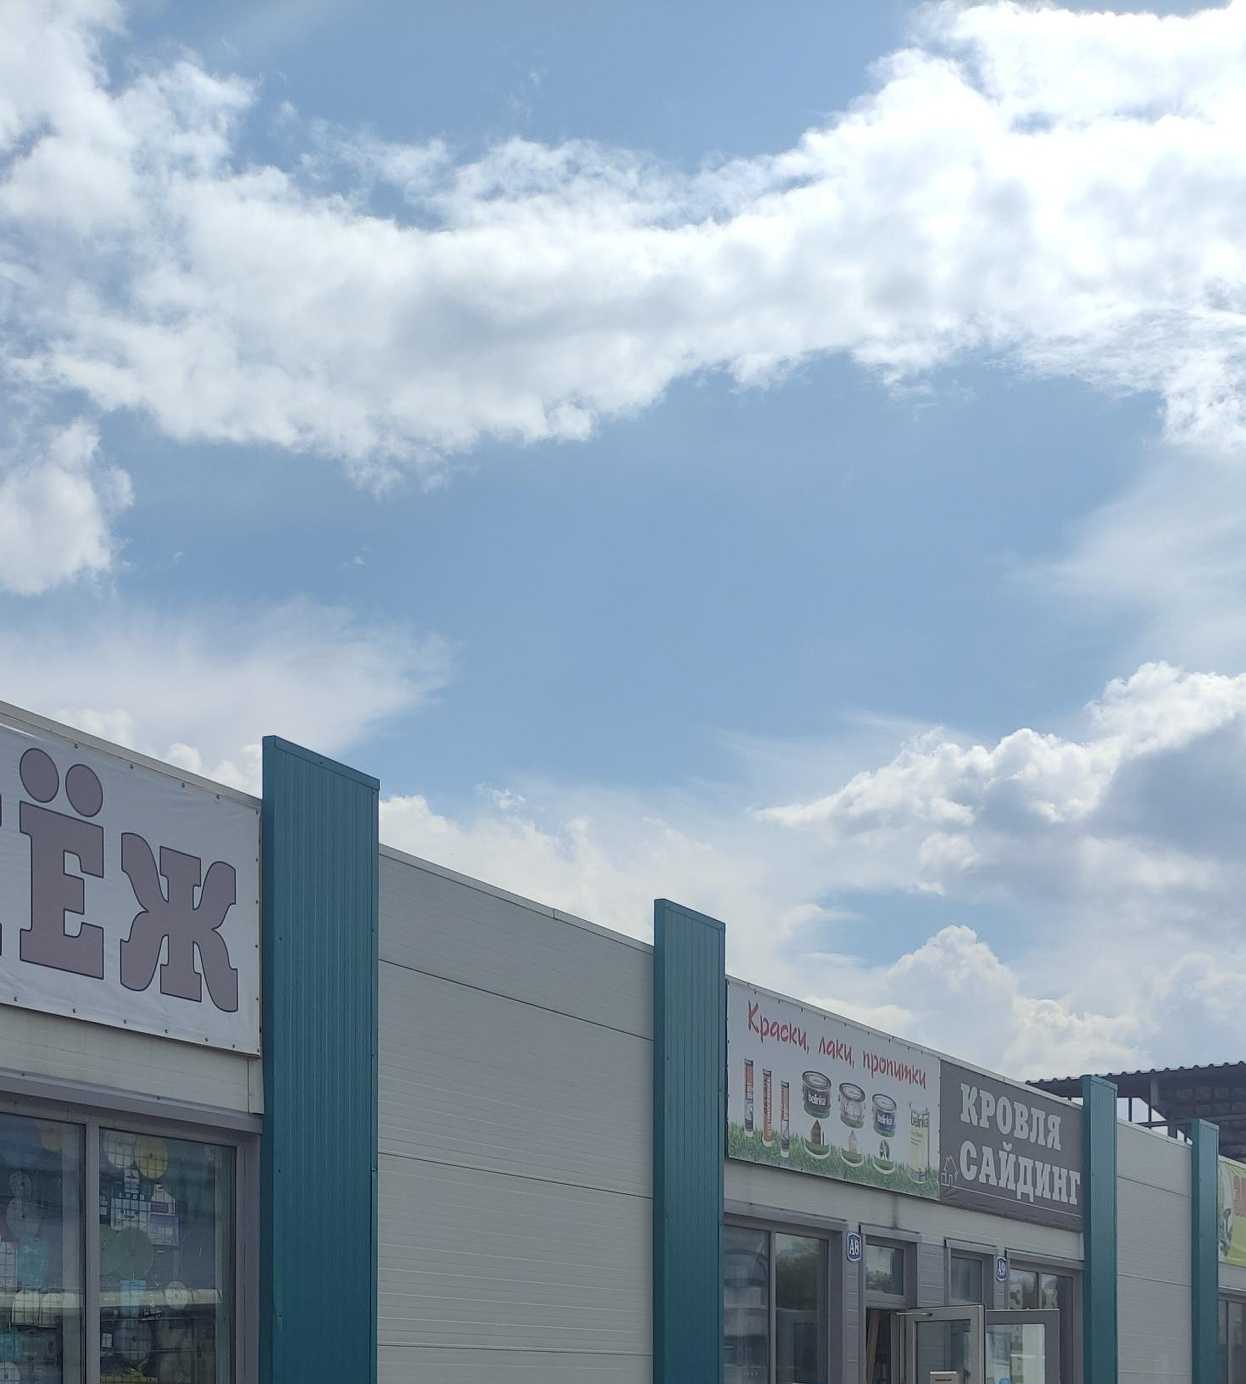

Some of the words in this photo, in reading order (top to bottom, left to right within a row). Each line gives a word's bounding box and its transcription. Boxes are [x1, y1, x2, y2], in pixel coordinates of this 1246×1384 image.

[0, 748, 239, 1012] ЁЖ
[748, 1000, 809, 1054] Краски,
[818, 1036, 855, 1069] лаки,
[862, 1049, 927, 1089] пропитки
[960, 1082, 1062, 1151] КРОВЛЯ
[959, 1140, 1081, 1206] САЙДИНГ
